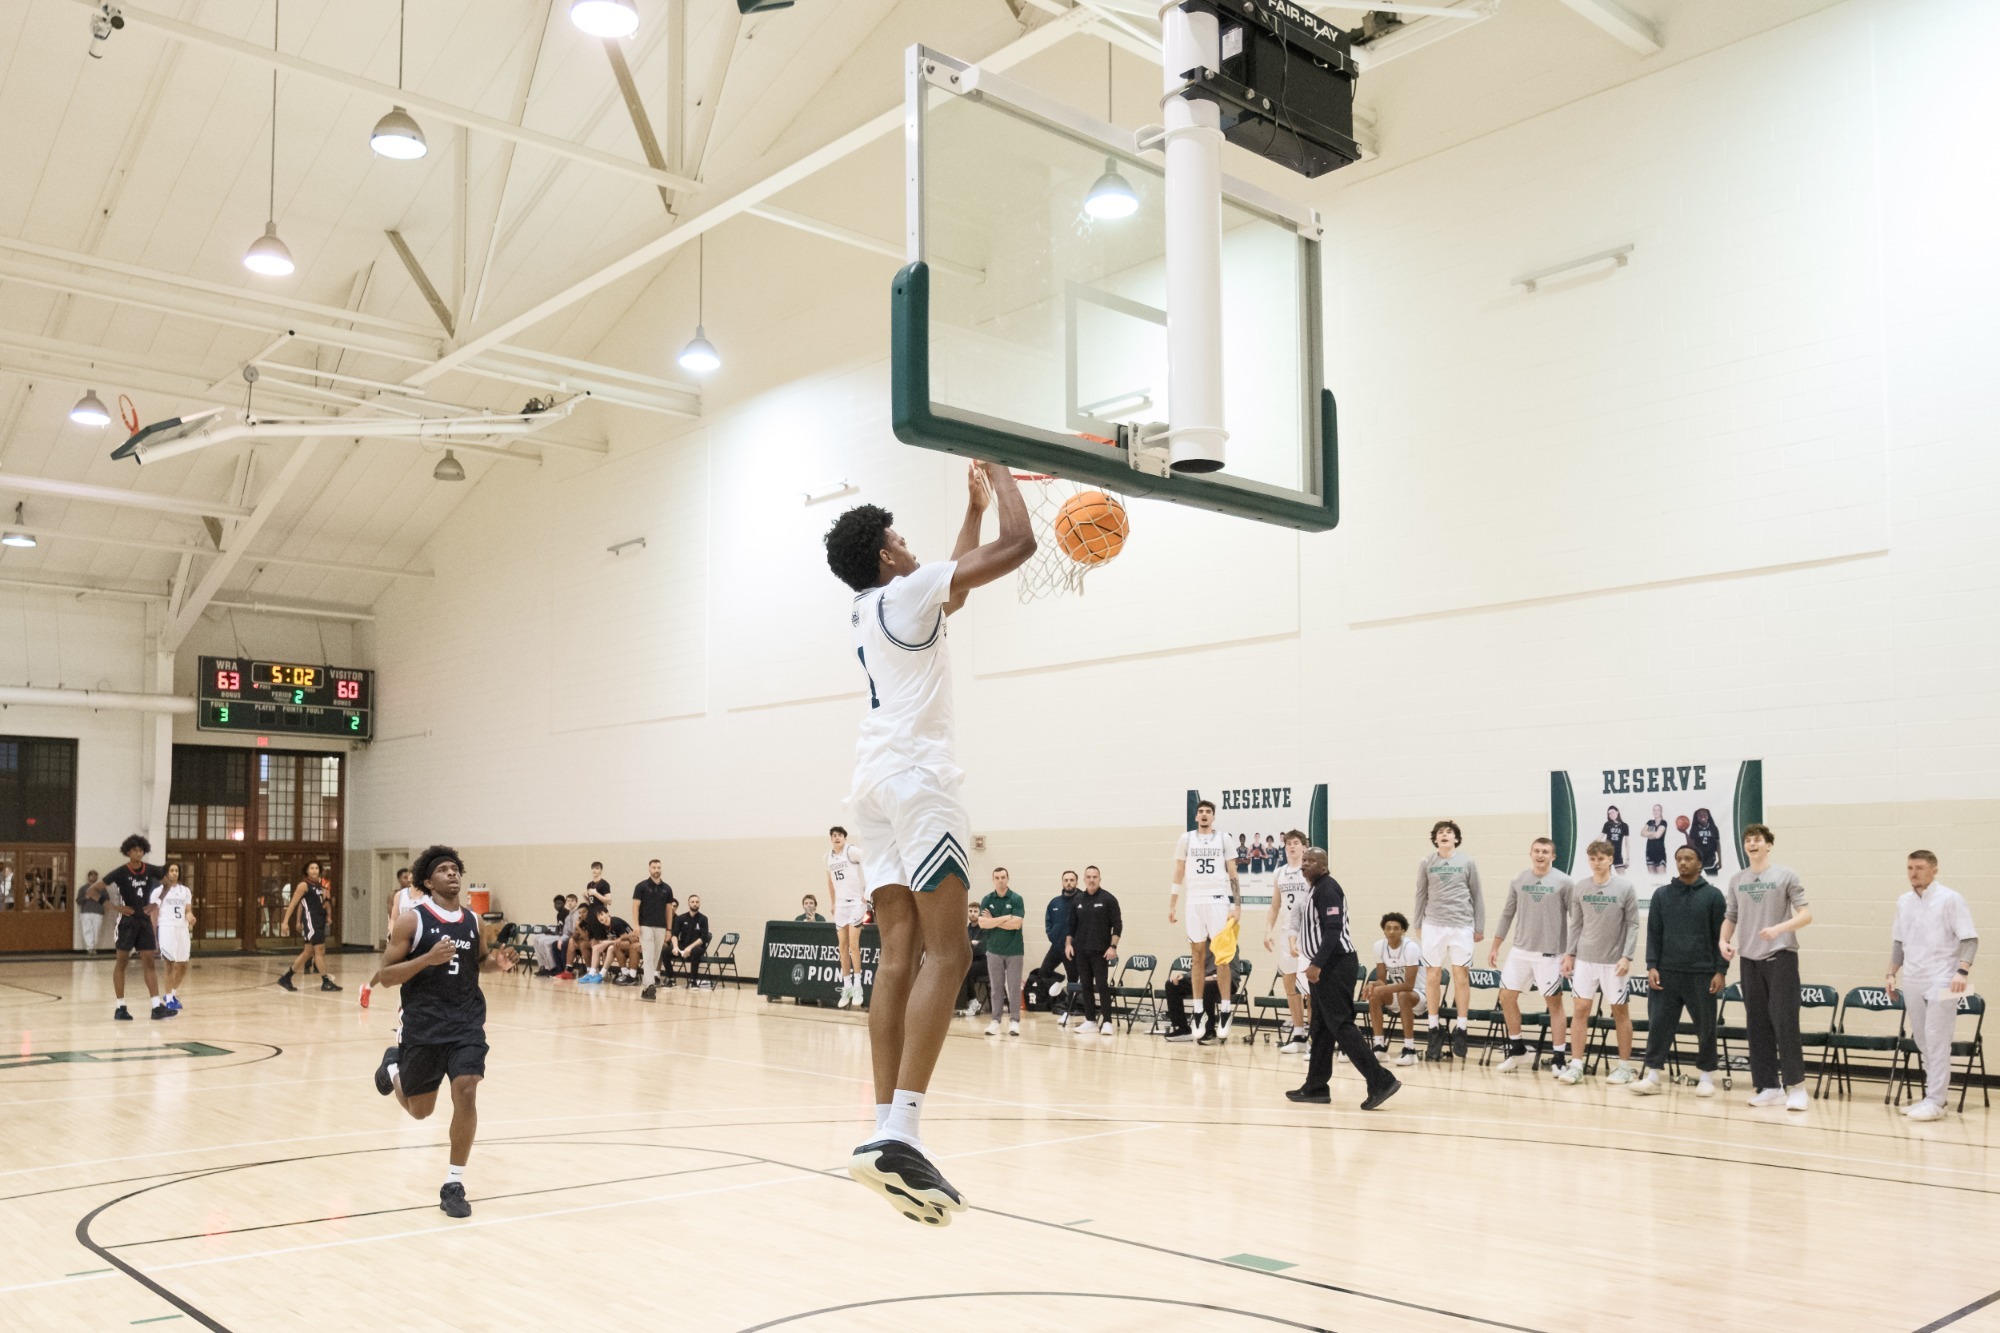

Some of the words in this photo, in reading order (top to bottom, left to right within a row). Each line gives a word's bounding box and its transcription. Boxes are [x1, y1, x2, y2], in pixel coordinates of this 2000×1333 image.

[216, 660, 239, 670] WRA
[217, 671, 240, 690] 63
[272, 666, 315, 686] 5:02
[330, 670, 363, 681] VISITOR
[271, 691, 292, 699] PERIOD
[294, 689, 304, 705] 2
[337, 681, 359, 699] 60
[220, 708, 229, 722] 3
[351, 716, 360, 730] 2
[1602, 765, 1706, 794] RESERVE
[1222, 787, 1291, 810] RESERVE
[1196, 858, 1215, 874] 35
[834, 869, 845, 880] 15
[137, 887, 143, 897] 4
[1738, 882, 1777, 892] RESERVE
[1582, 895, 1617, 903] RESERVE
[174, 906, 182, 919] 5
[768, 942, 819, 960] WESTERN
[448, 953, 459, 975] 5
[1132, 956, 1149, 968] WRA
[1469, 971, 1495, 985] WRA
[1858, 989, 1893, 1006] WRA
